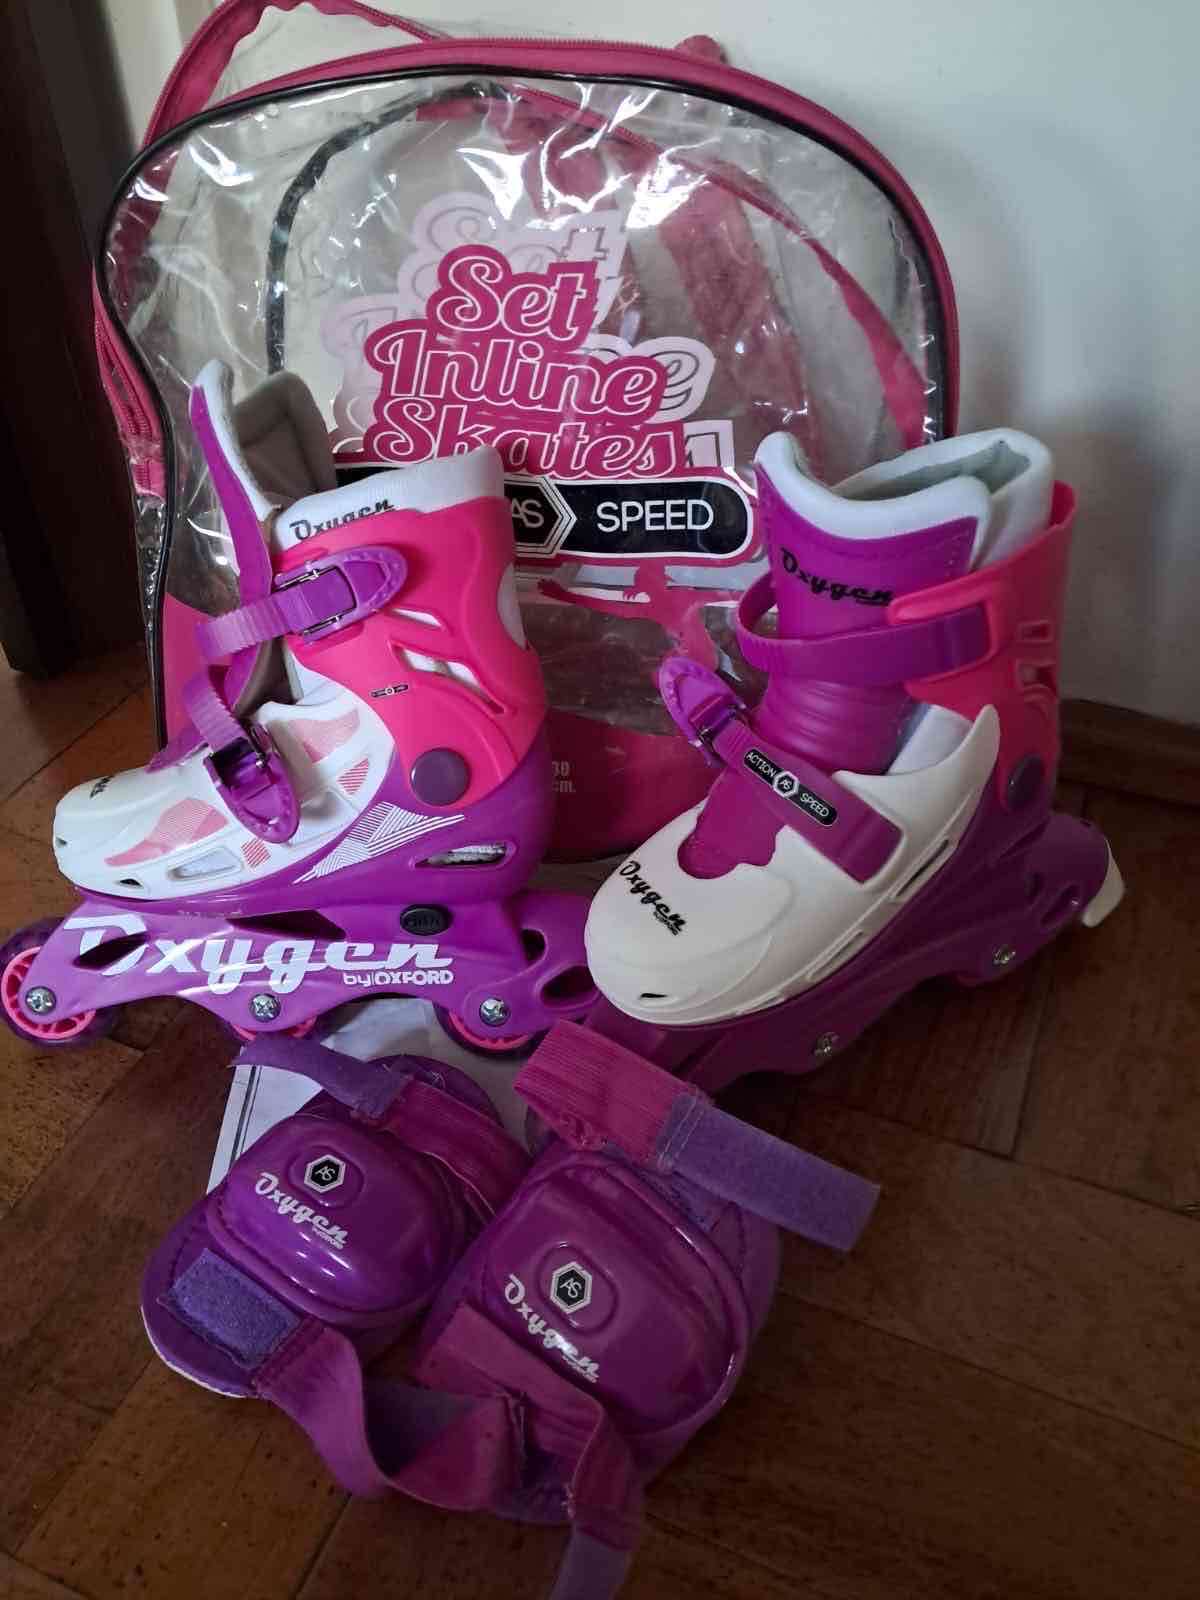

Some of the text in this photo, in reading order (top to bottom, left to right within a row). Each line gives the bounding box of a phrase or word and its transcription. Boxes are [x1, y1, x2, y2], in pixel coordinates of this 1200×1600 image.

[436, 256, 588, 341] Set
[373, 328, 658, 416] Inline
[373, 397, 678, 479] Skates
[596, 499, 715, 532] SPEED
[780, 547, 894, 608] Oxygen
[746, 752, 777, 777] ACTION
[800, 793, 830, 817] SPEED
[619, 860, 686, 932] Oxygen
[63, 913, 454, 995] Oxygen
[343, 969, 455, 987] by OXFORD
[255, 1171, 349, 1245] Oxygen
[504, 1273, 600, 1378] Oxygen
